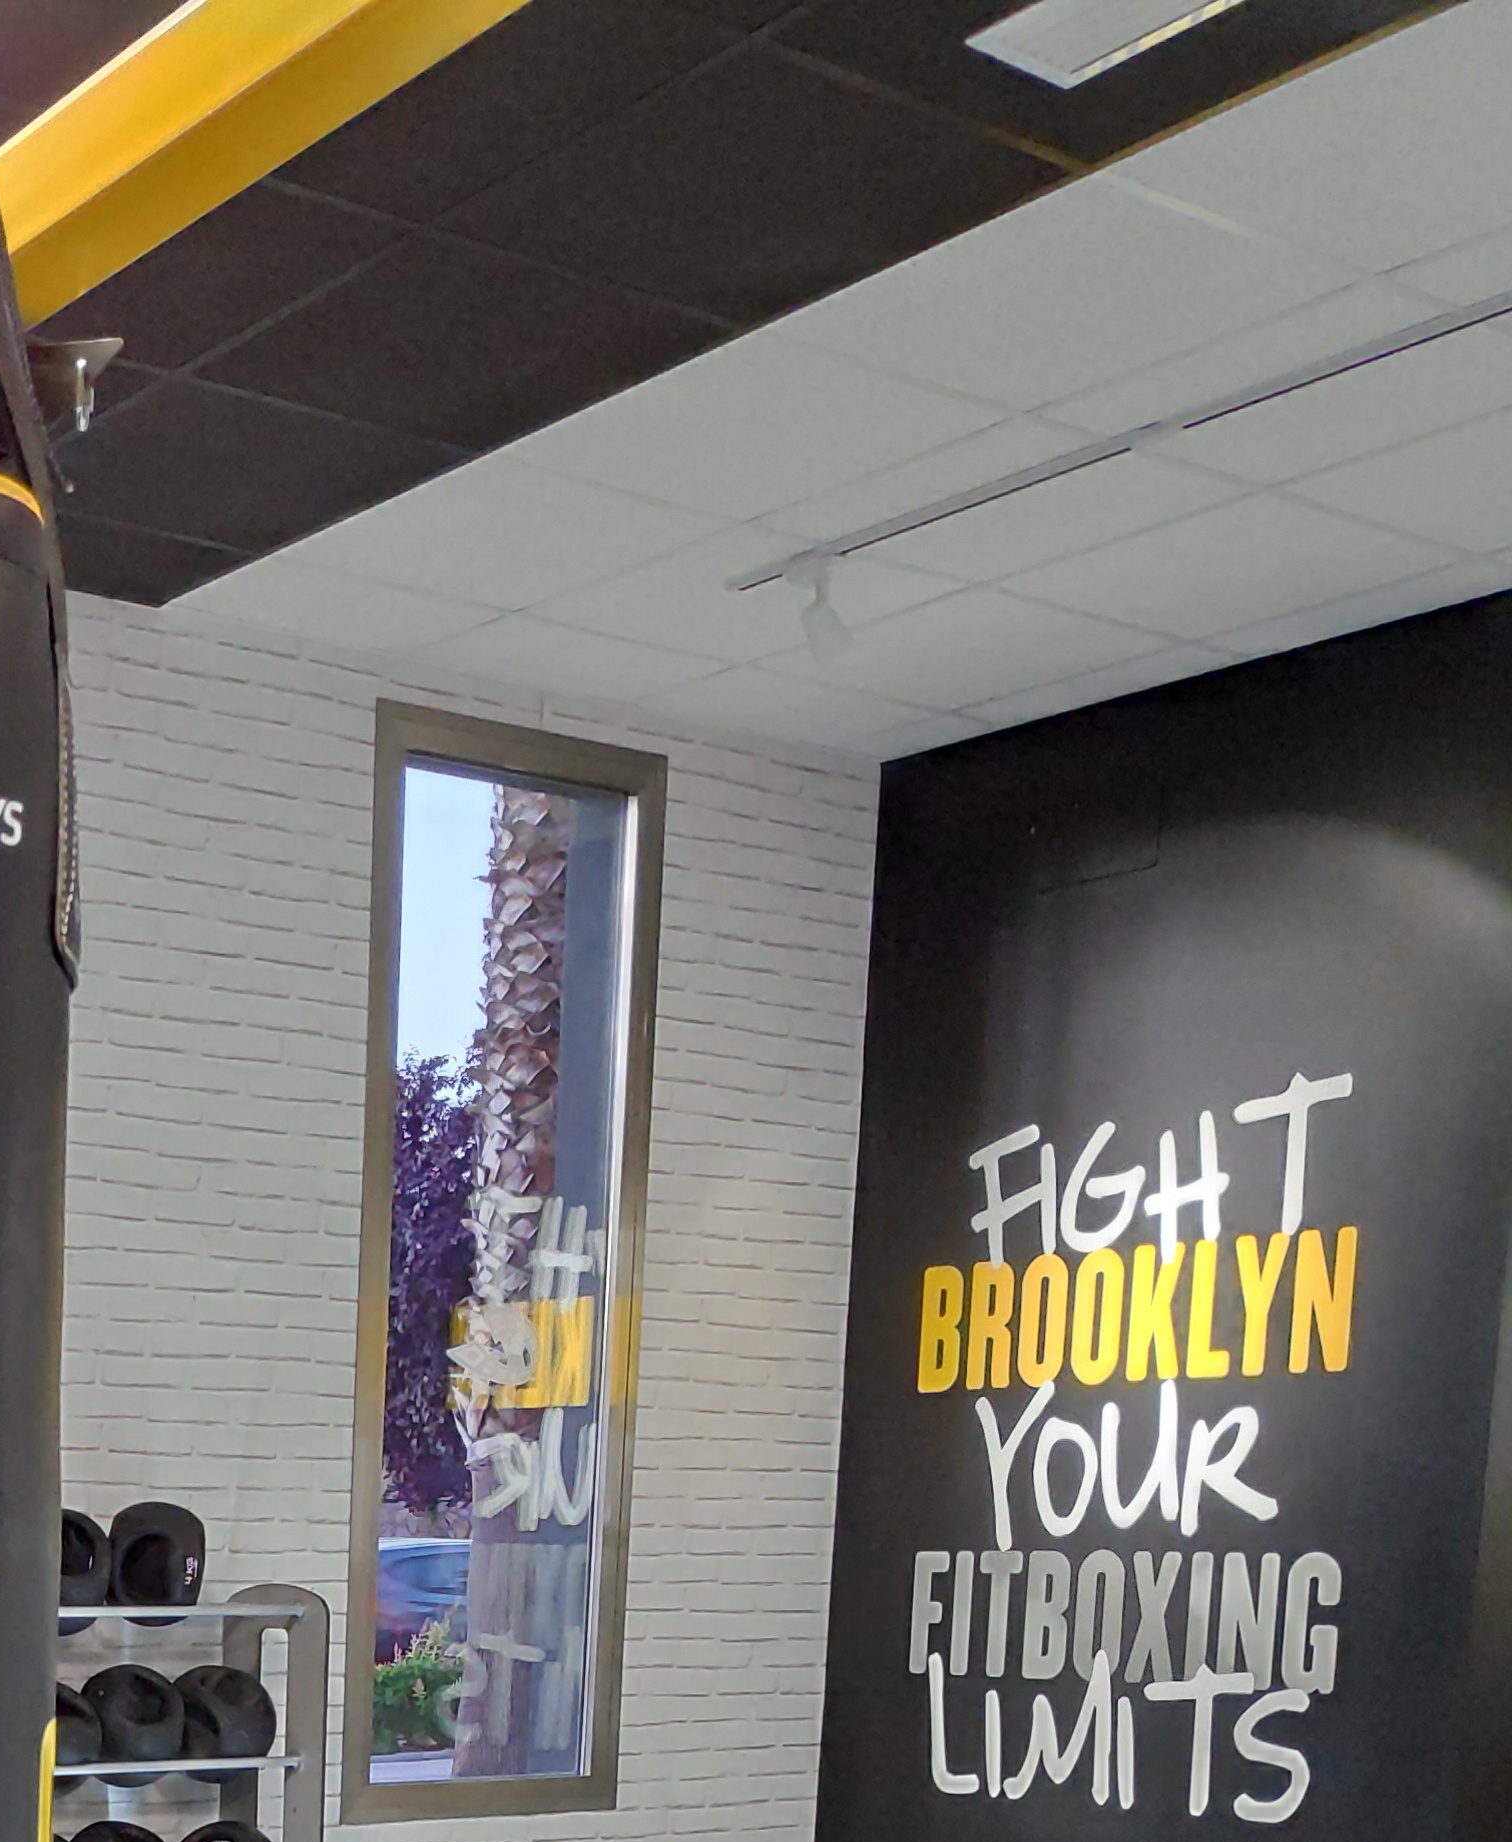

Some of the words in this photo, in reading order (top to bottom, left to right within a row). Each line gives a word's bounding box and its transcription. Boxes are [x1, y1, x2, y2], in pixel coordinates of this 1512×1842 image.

[969, 1072, 1353, 1268] FIGHT
[917, 1227, 1358, 1394] BROOKLYN
[975, 1379, 1278, 1552] YOUR
[908, 1549, 1342, 1694] FITBOXING
[928, 1649, 1310, 1823] LIMITS
